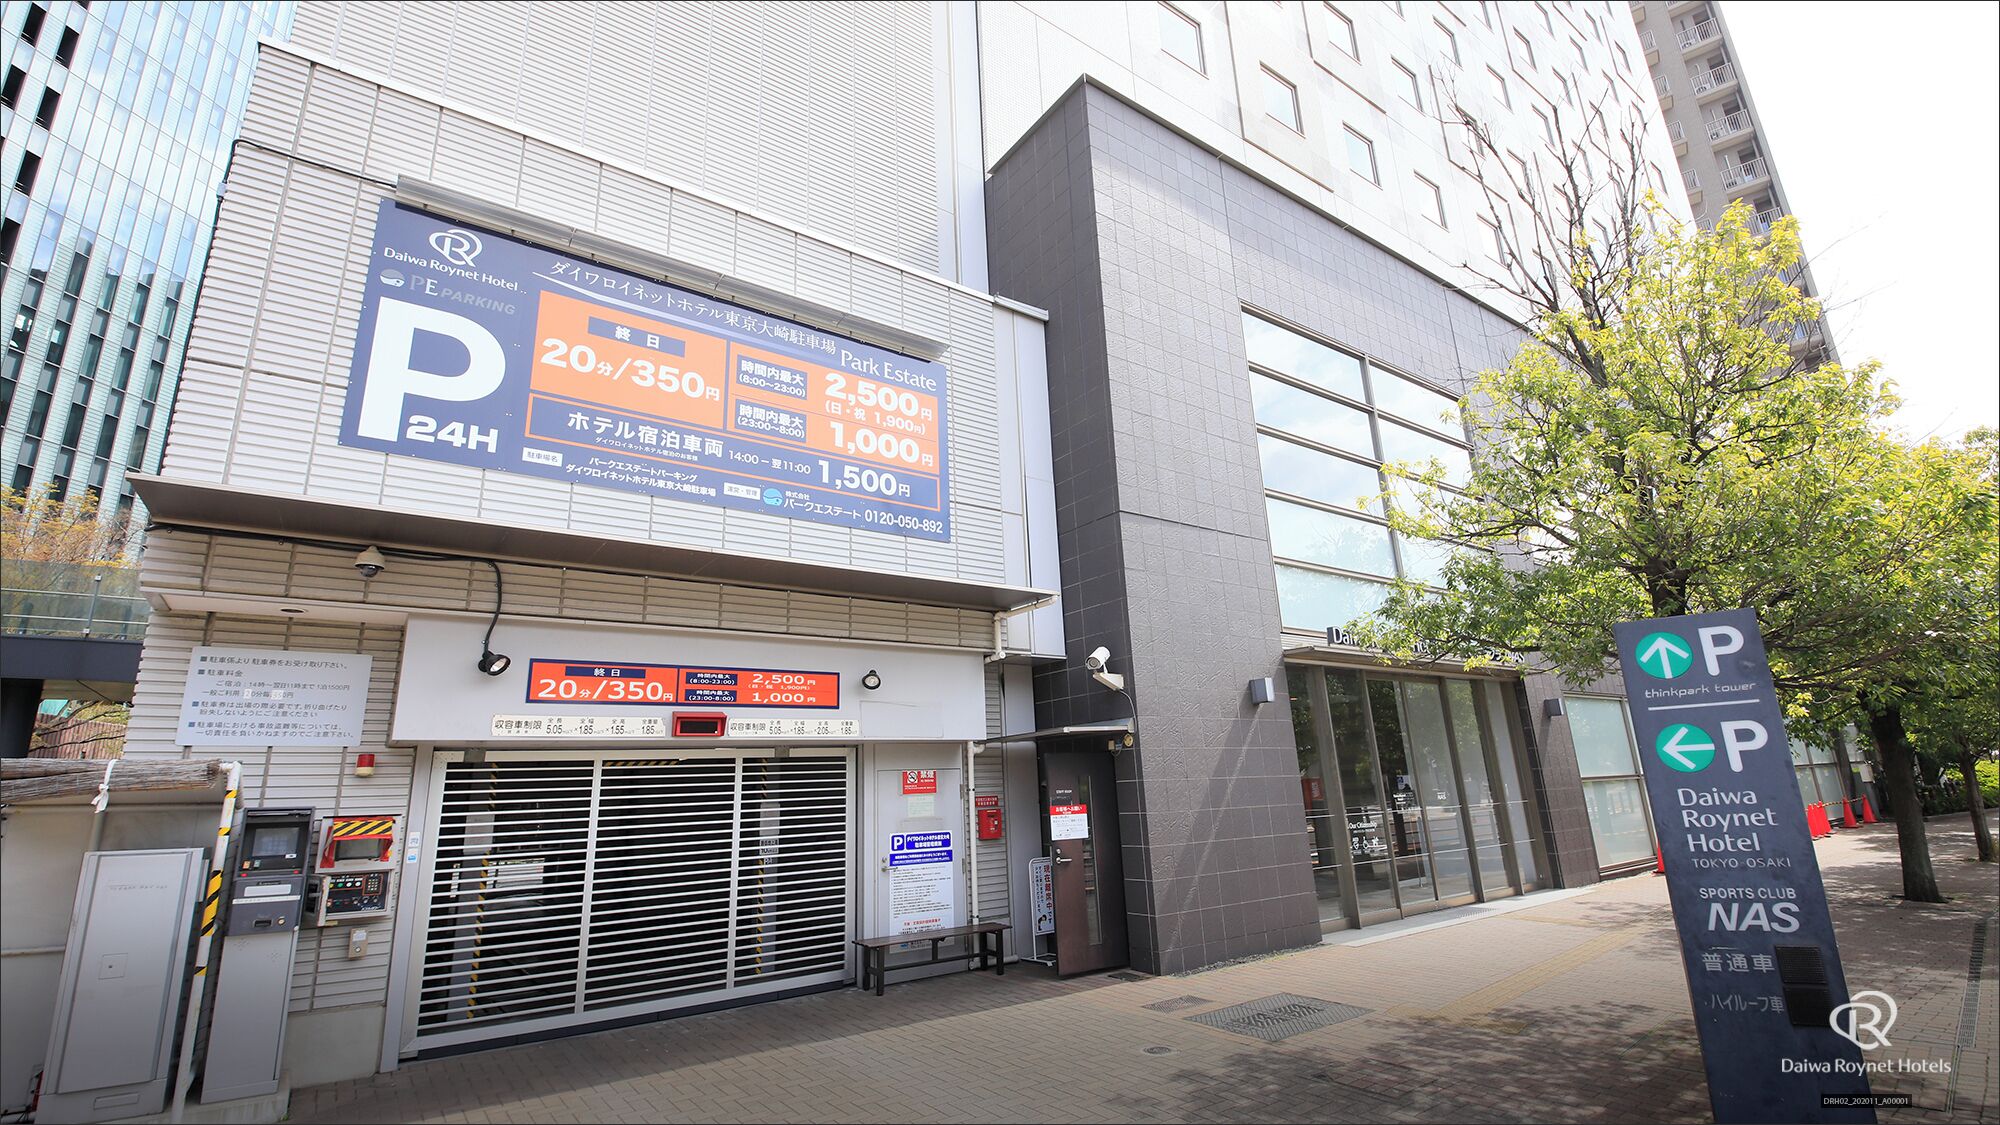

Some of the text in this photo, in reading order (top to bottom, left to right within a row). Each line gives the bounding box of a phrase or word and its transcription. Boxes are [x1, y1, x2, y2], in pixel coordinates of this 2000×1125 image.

[385, 247, 518, 291] Daiwa Roynet Hotel
[441, 288, 516, 315] PARKING
[551, 261, 836, 355] ダイワロイネットホテル東京大崎駐車場
[357, 296, 506, 441] P
[741, 360, 804, 386] 時間内最大
[841, 350, 937, 392] Park Estate
[825, 373, 932, 420] 2,500円
[740, 404, 804, 429] 時間内最大
[406, 415, 498, 453] 24H
[568, 412, 723, 458] ホテル宿泊車両
[830, 421, 933, 467] 1,000円
[566, 464, 716, 497] ダイワロイネットホテル東京大崎駐車場
[589, 457, 698, 483] パークエステートパーキング
[818, 460, 911, 498] 1,500円
[784, 498, 861, 519] パークエステート
[865, 510, 942, 533] 0120-050-892
[1698, 625, 1744, 676] P
[208, 669, 244, 677] 駐車料金
[752, 674, 815, 686] 2,500円
[752, 692, 815, 703] 1,000円
[1645, 682, 1756, 699] thinkpark tower
[495, 720, 542, 729] 収容車制限
[1721, 720, 1768, 772] P
[1677, 788, 1757, 806] Daiwa
[1681, 808, 1779, 832] Roynet
[893, 836, 904, 850] P
[1687, 833, 1760, 852] Hotel
[1700, 888, 1797, 900] SPORTS CLUB
[1708, 902, 1800, 933] NAS
[1702, 952, 1776, 973] 普通車
[1711, 994, 1785, 1014] ハイルーフ車
